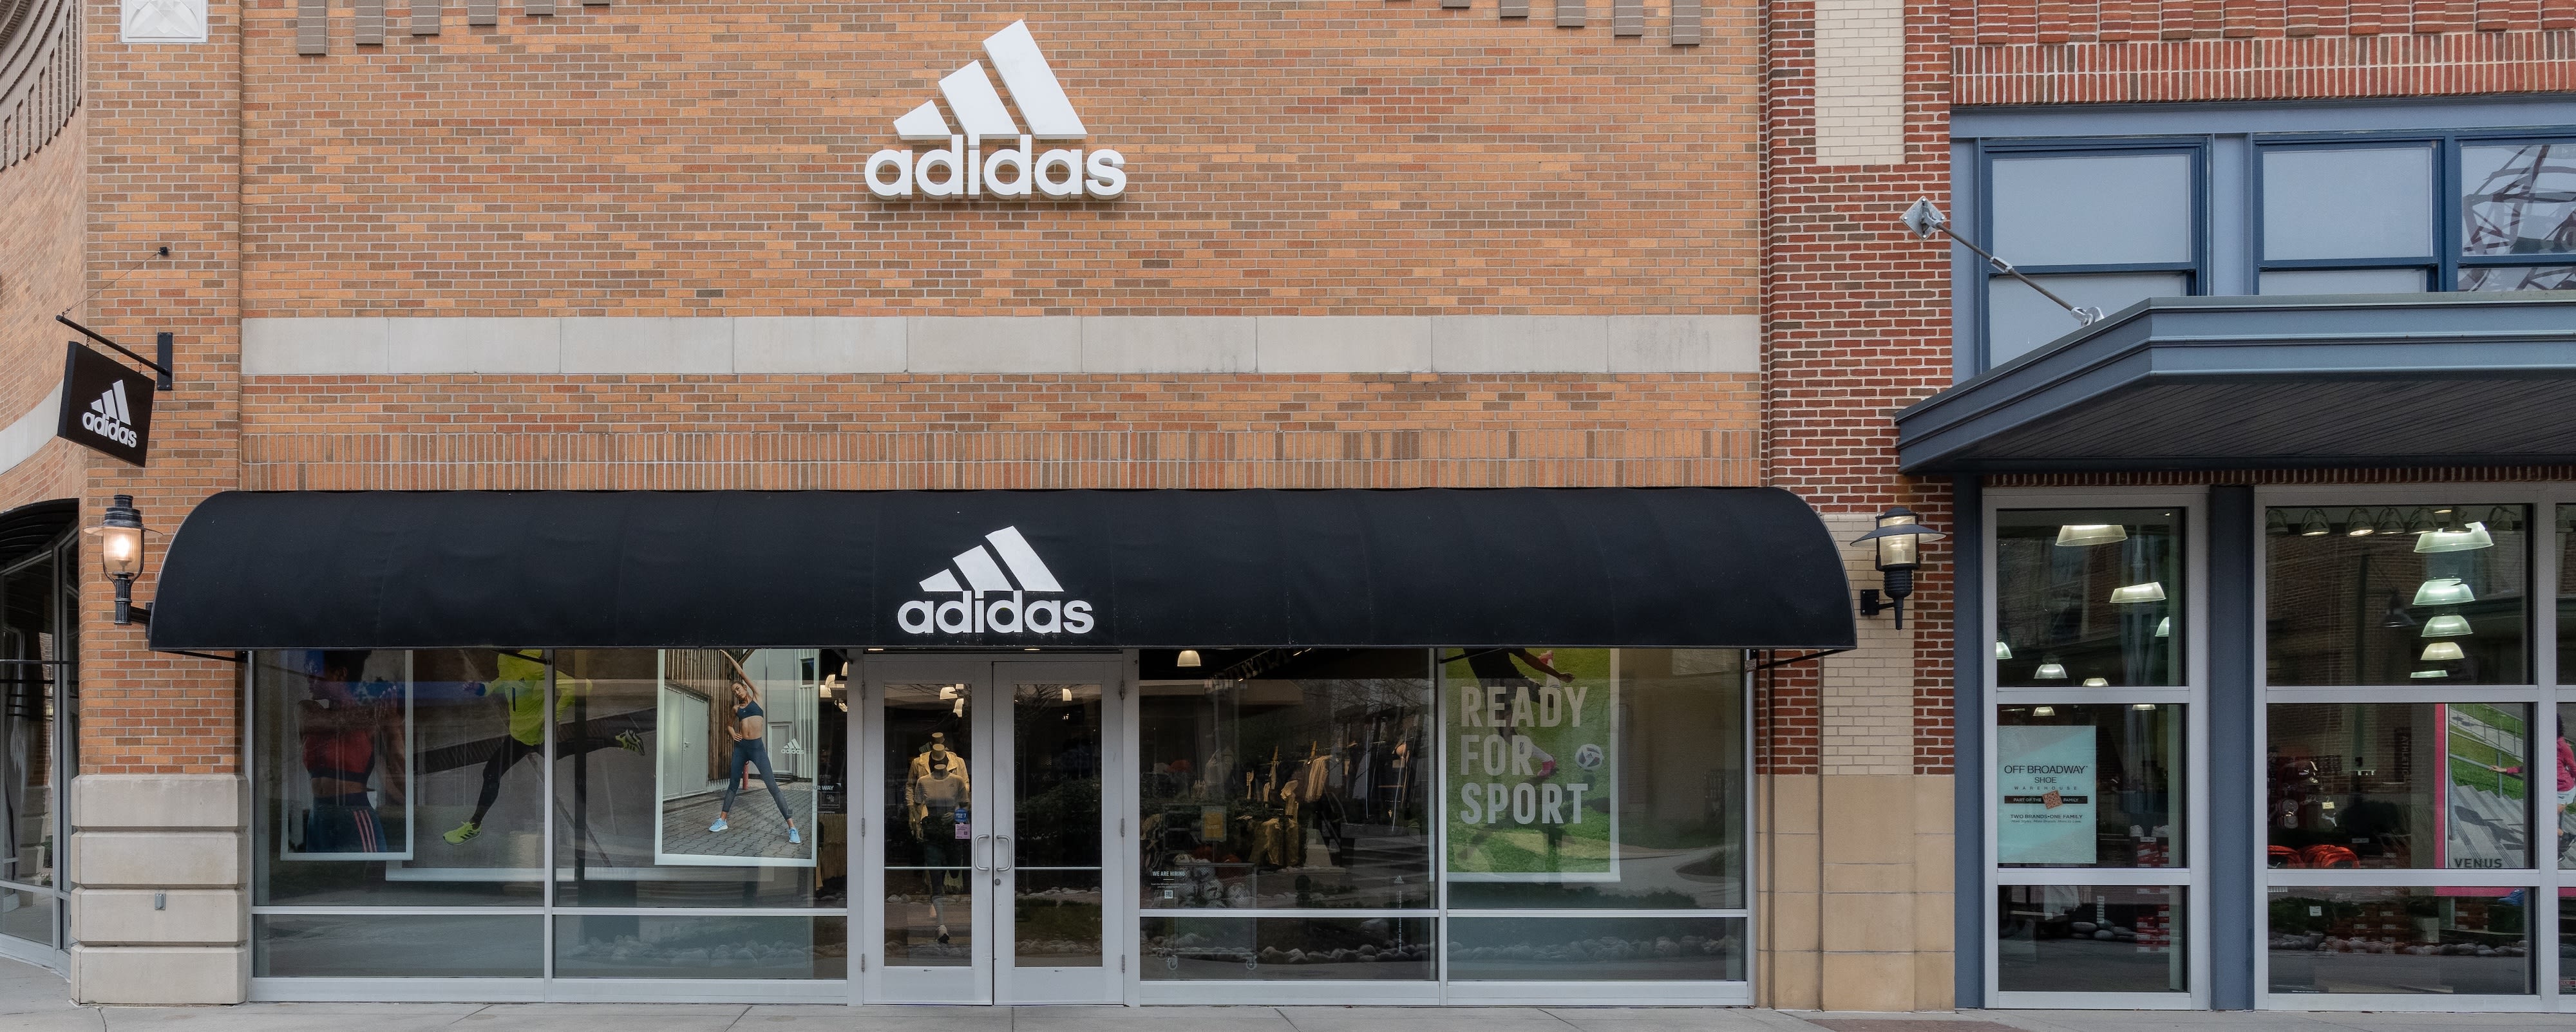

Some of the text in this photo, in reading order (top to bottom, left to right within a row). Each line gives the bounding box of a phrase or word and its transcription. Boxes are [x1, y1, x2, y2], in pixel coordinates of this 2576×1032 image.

[864, 133, 1127, 199] adidas
[82, 411, 137, 448] adidas
[897, 589, 1094, 634] adidas
[1461, 686, 1587, 727] READY
[1461, 734, 1535, 776] FOR
[2004, 765, 2085, 774] OFF BROADWAY
[1461, 782, 1588, 825] SPORT
[2454, 858, 2503, 868] VENUS
